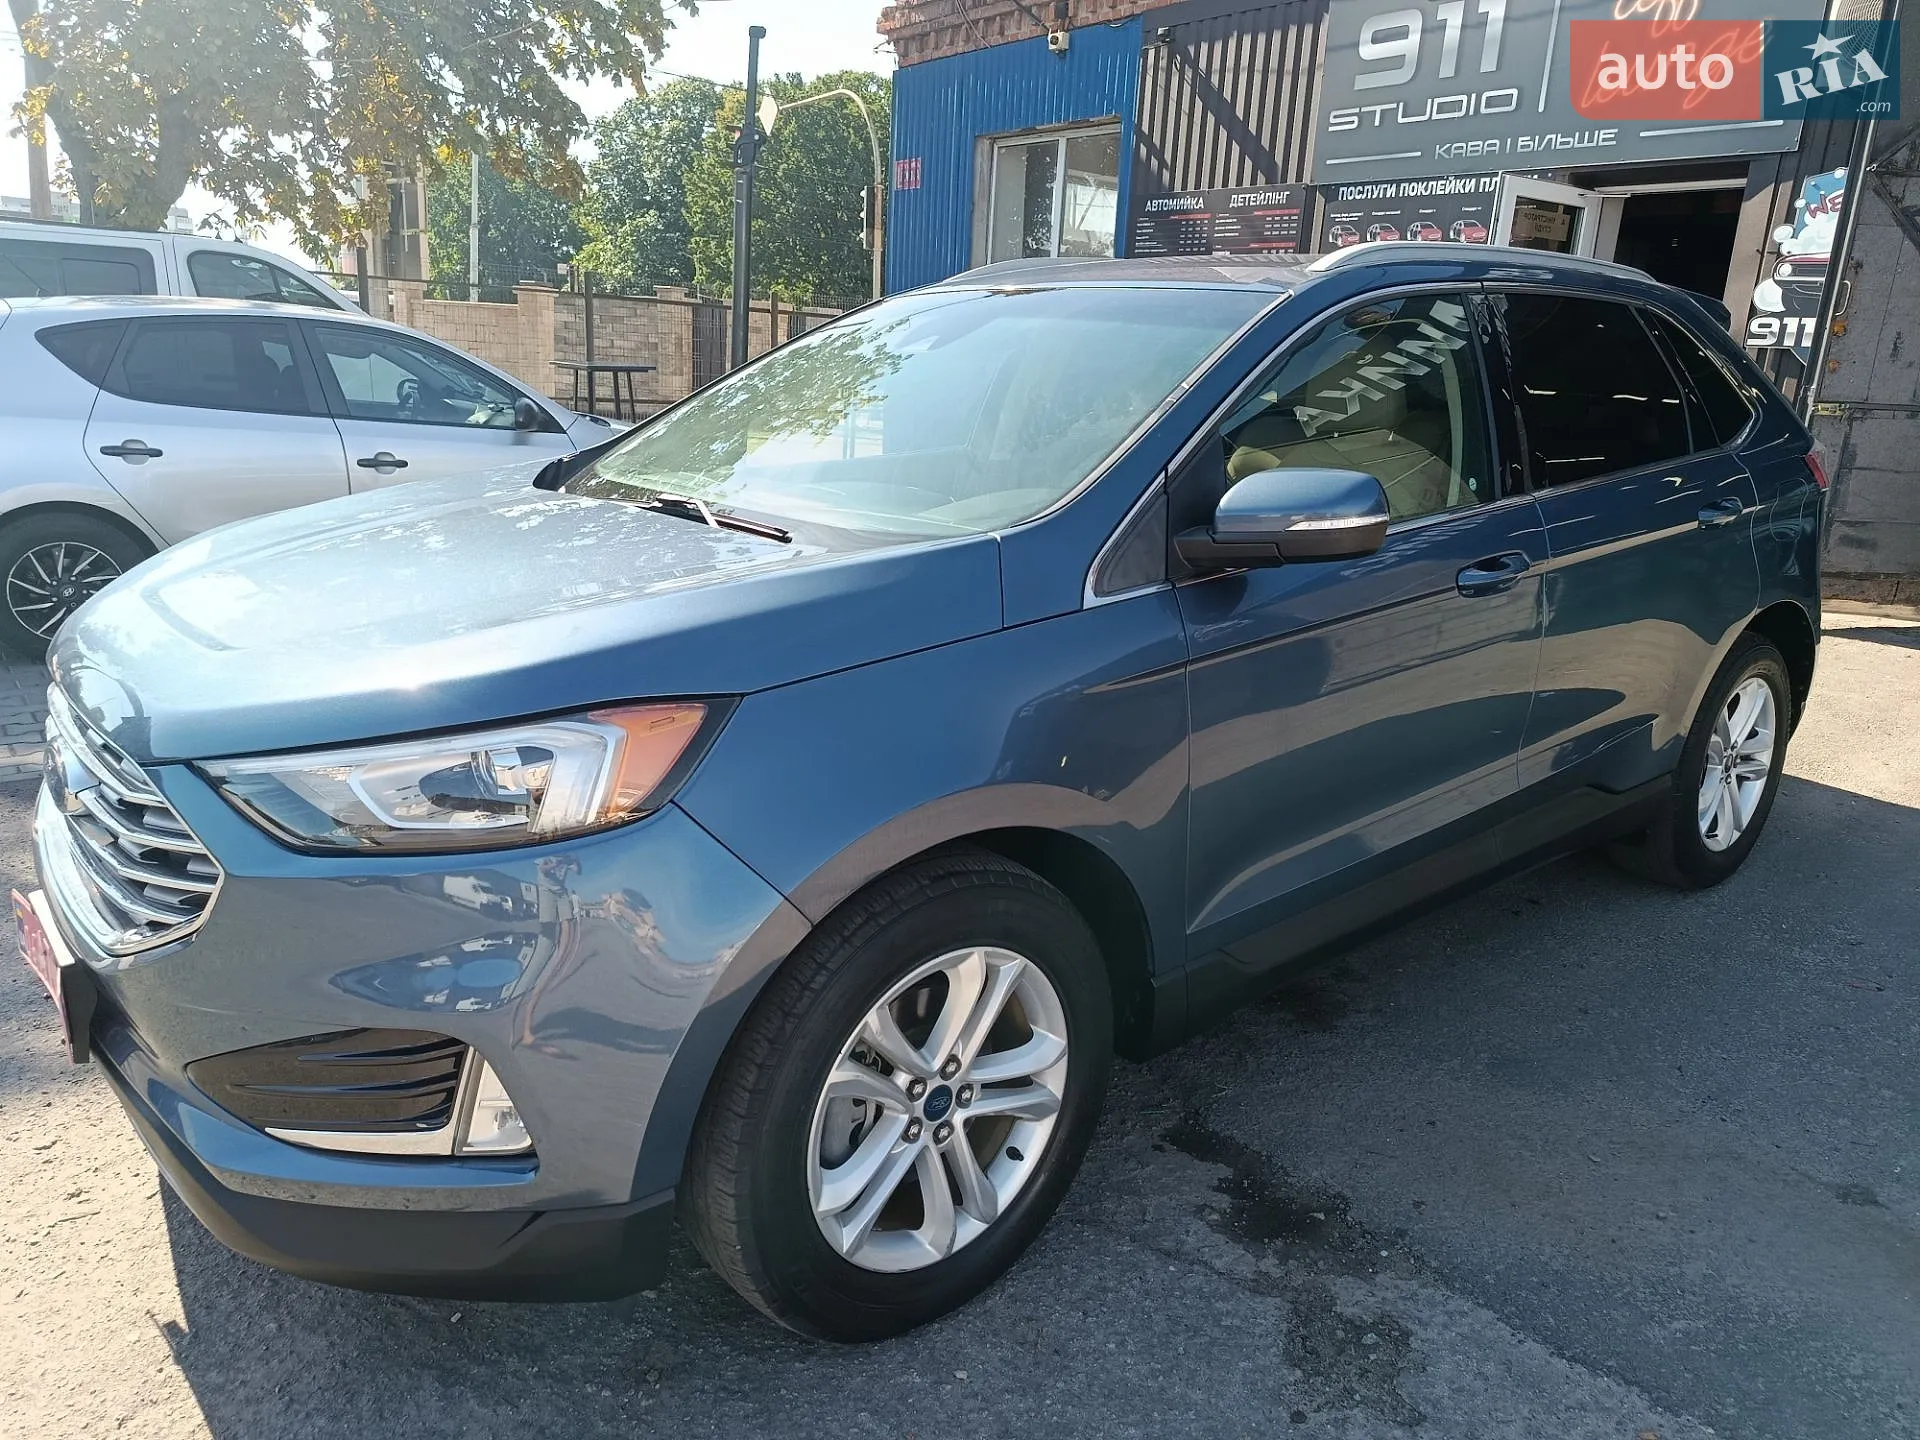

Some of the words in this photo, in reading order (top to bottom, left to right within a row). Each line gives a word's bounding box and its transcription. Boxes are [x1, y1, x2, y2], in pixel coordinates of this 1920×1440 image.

[1353, 0, 1506, 90] 911
[1328, 88, 1519, 132] STUDIO
[1434, 139, 1500, 160] КАВА
[1516, 128, 1619, 153] БІЛЬШЕ
[1229, 190, 1290, 208] ДЕТЕЙЛІНГ
[1338, 183, 1397, 201] ПОСЛУГИ
[1400, 175, 1476, 198] ПОКЛЕЙКИ
[1144, 195, 1205, 212] АВТОМИЙКА
[1746, 317, 1817, 347] 911
